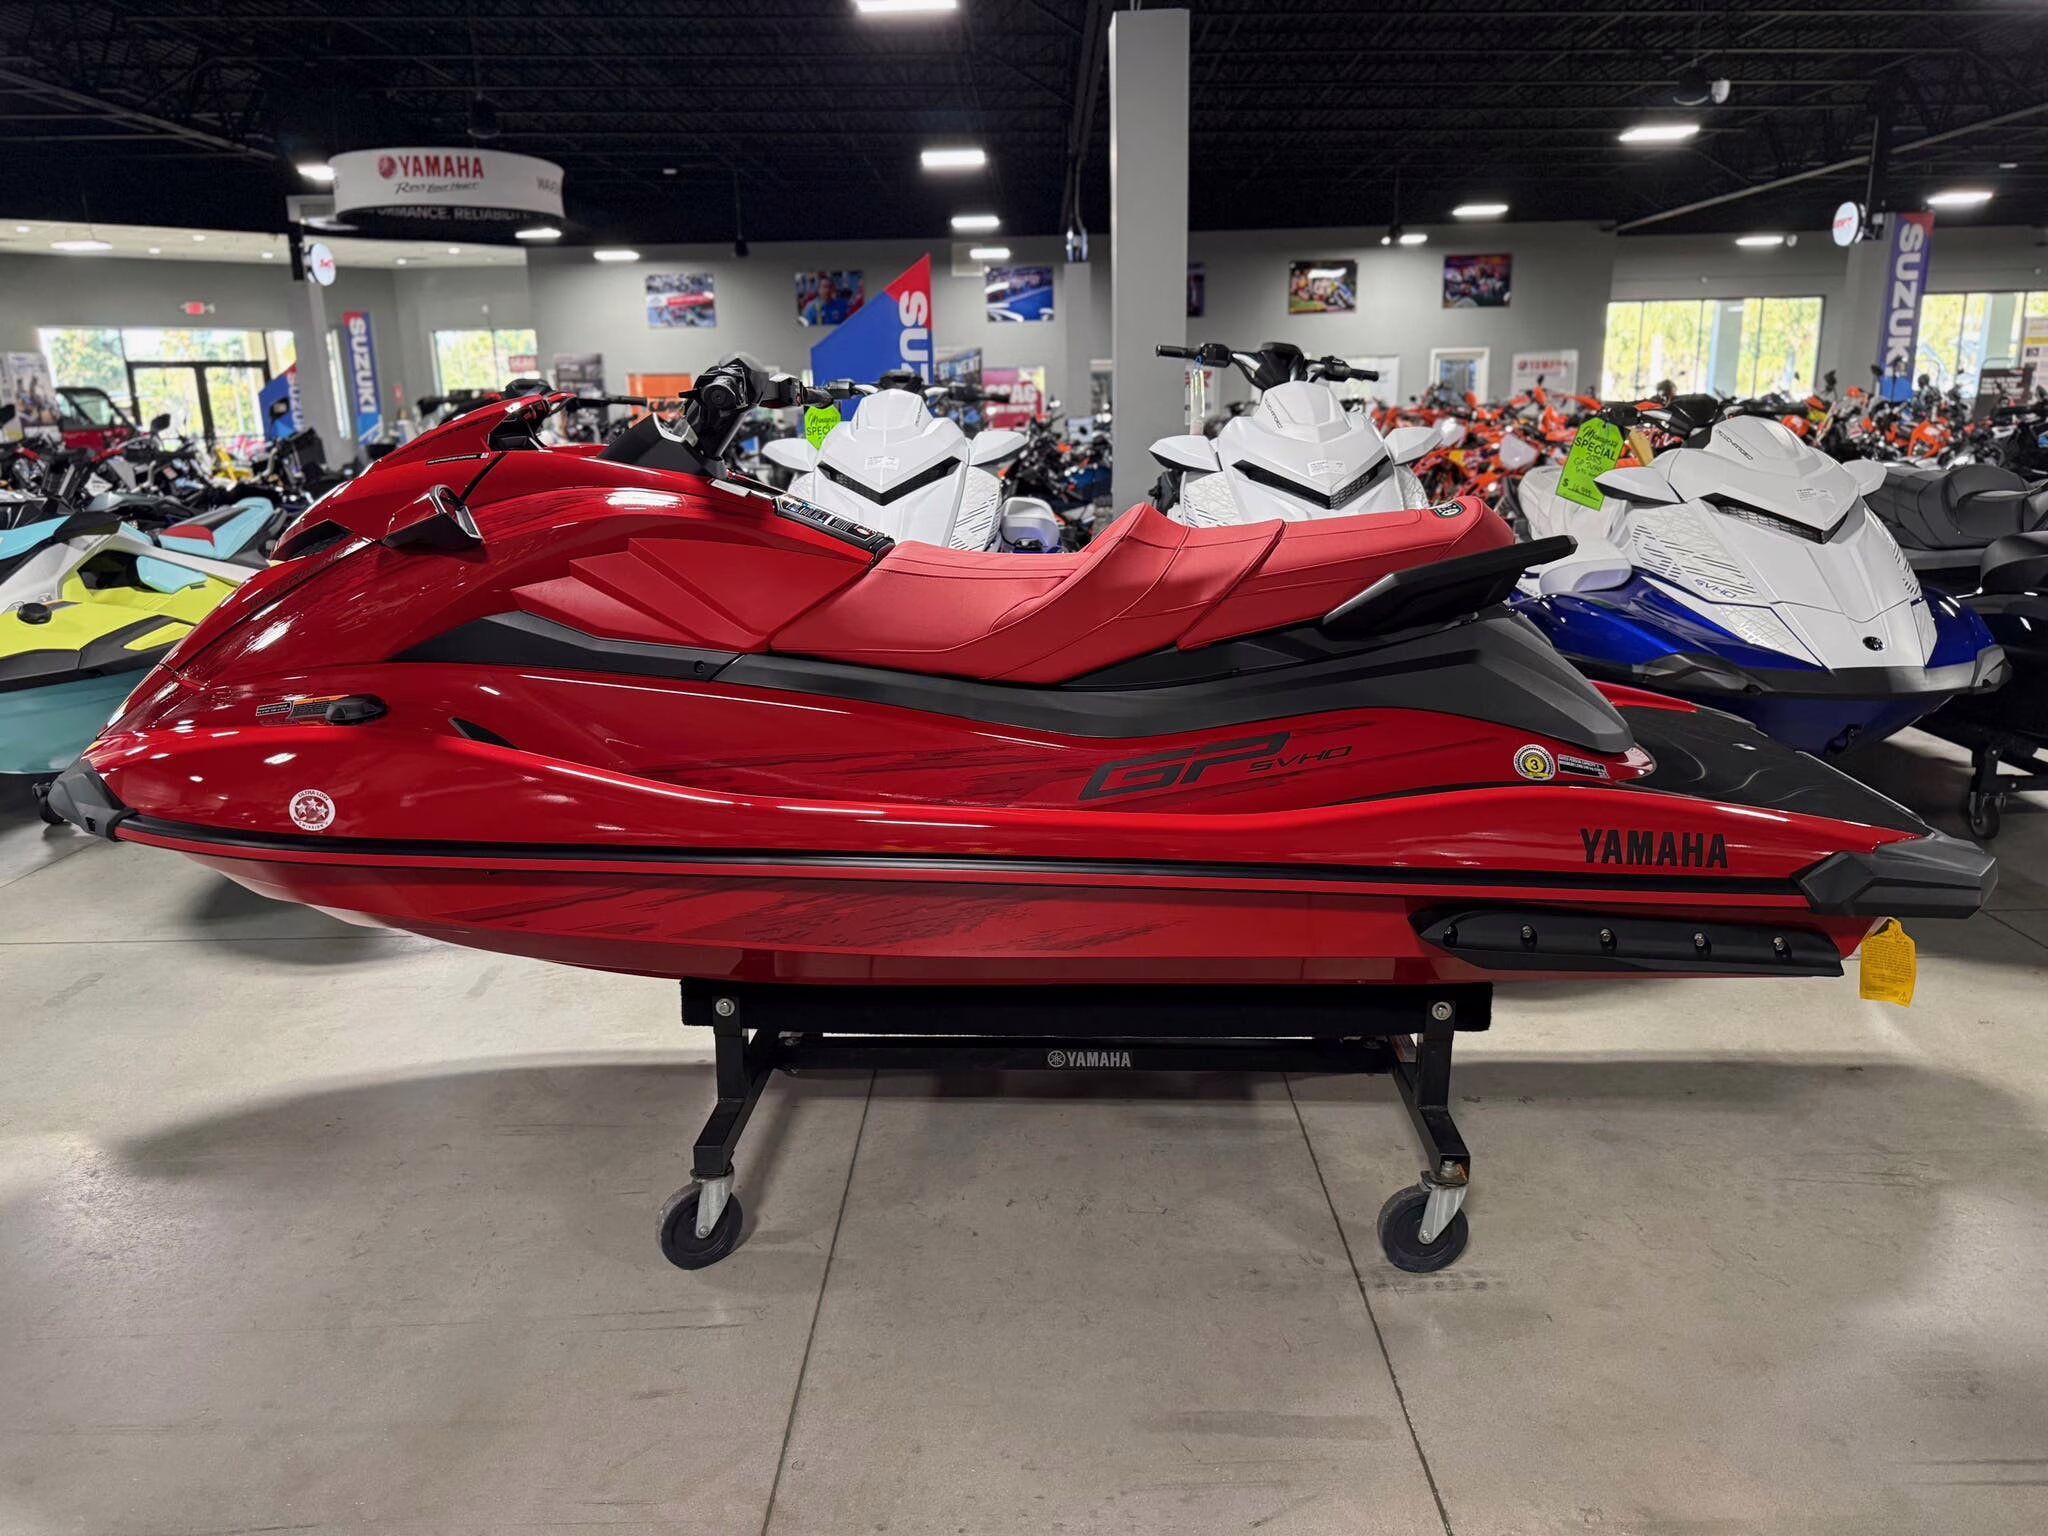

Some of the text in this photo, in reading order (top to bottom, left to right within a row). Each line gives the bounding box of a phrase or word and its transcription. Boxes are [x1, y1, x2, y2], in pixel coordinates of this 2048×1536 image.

[399, 156, 485, 179] YAMAHA
[349, 316, 377, 413] SUZUKI
[1574, 436, 1616, 462] SPECIAL
[1562, 478, 1569, 487] $
[1694, 578, 1738, 599] SVHO
[1079, 731, 1291, 801] GP
[1247, 745, 1353, 773] SVHO
[1531, 757, 1539, 771] 3
[298, 790, 316, 798] ULTRA
[1580, 828, 1729, 869] YAMAHA
[1066, 1051, 1131, 1068] YAMAHA
